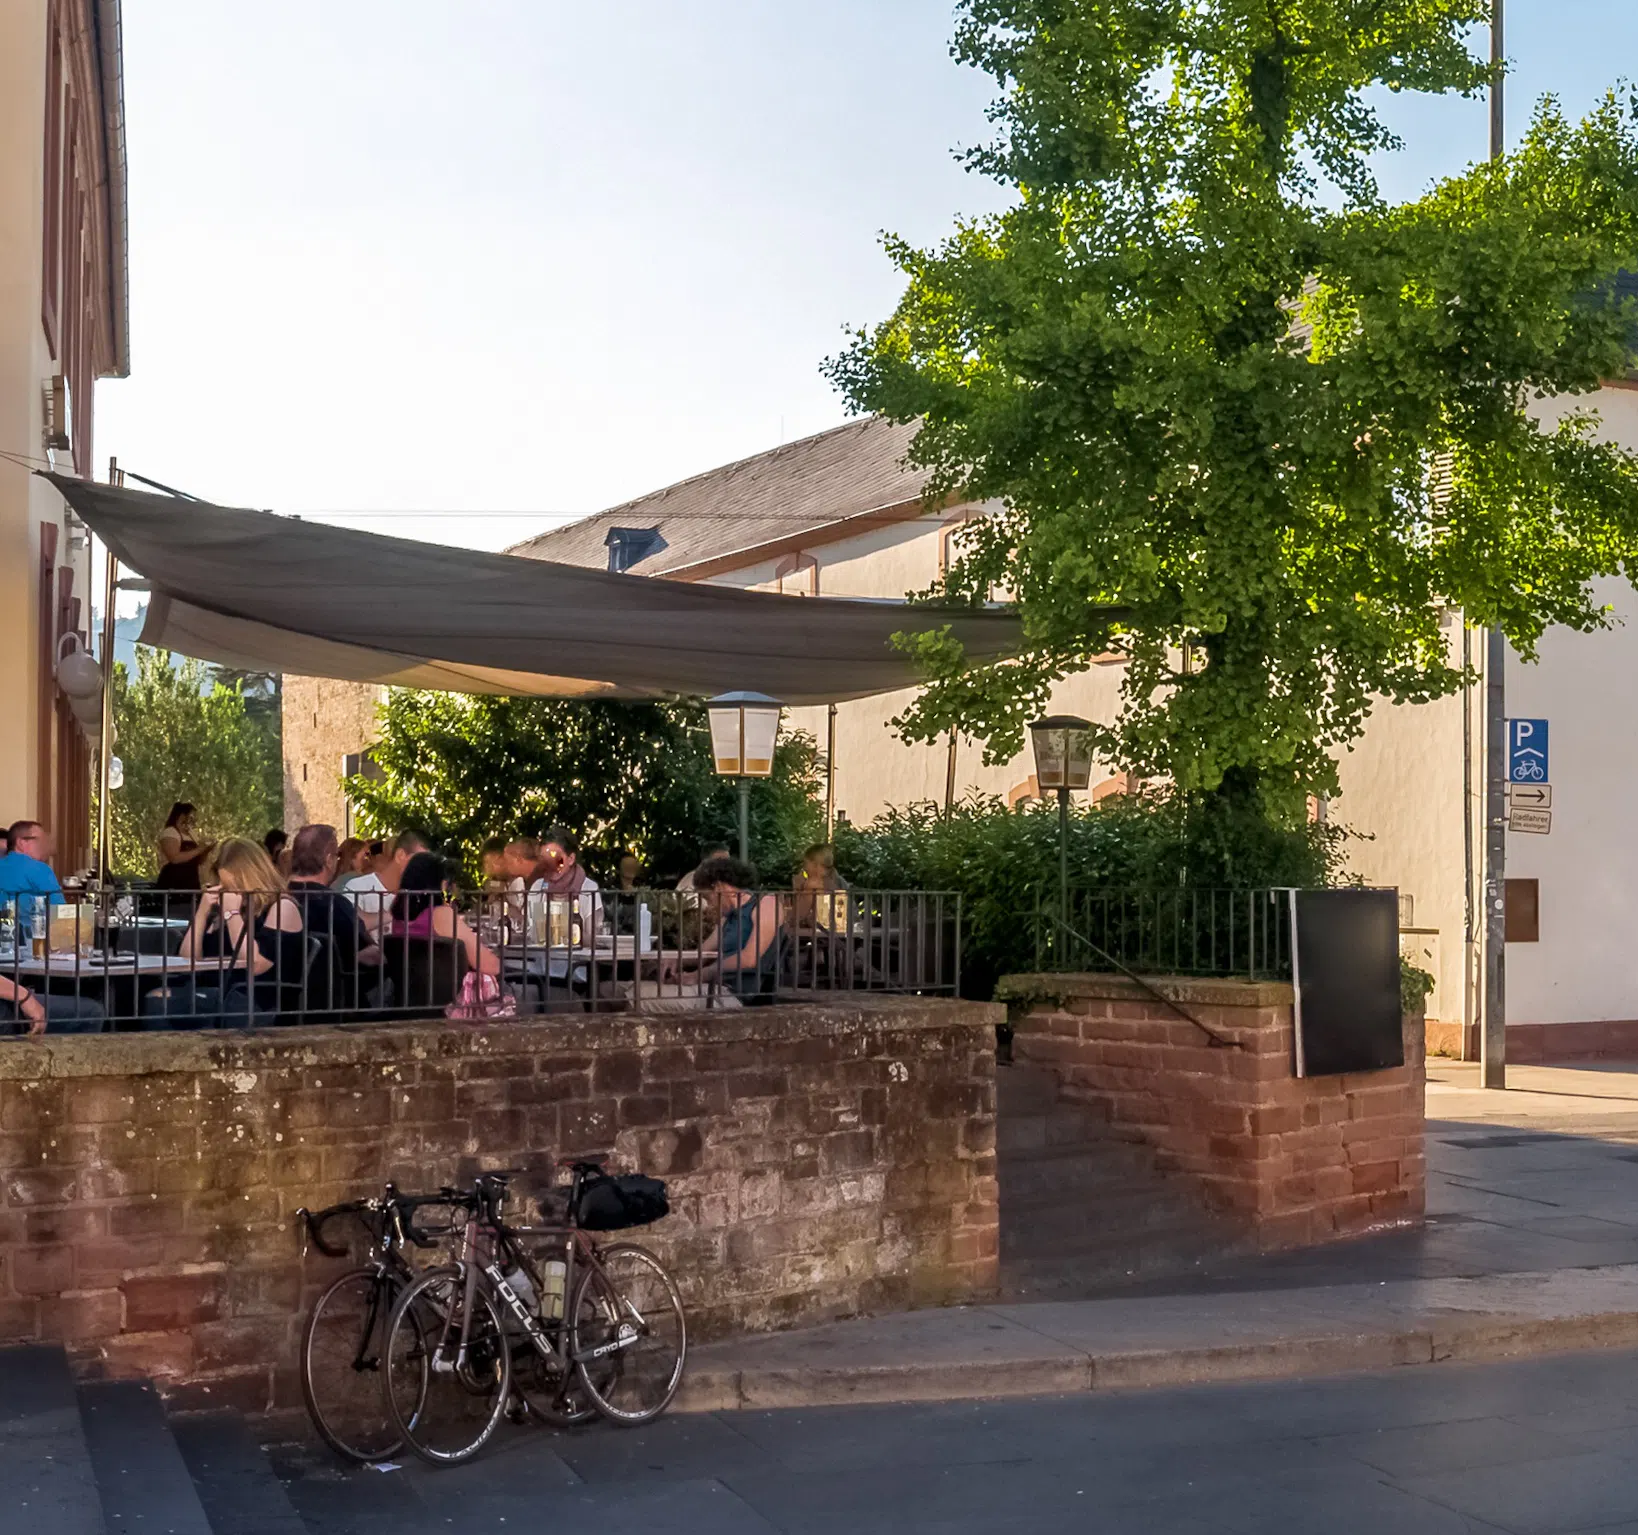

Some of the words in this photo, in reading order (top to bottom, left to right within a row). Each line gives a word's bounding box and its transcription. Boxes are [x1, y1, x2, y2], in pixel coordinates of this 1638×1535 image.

[1516, 721, 1534, 747] P
[1512, 812, 1549, 823] Radfahrer
[485, 1264, 554, 1355] FOCUS
